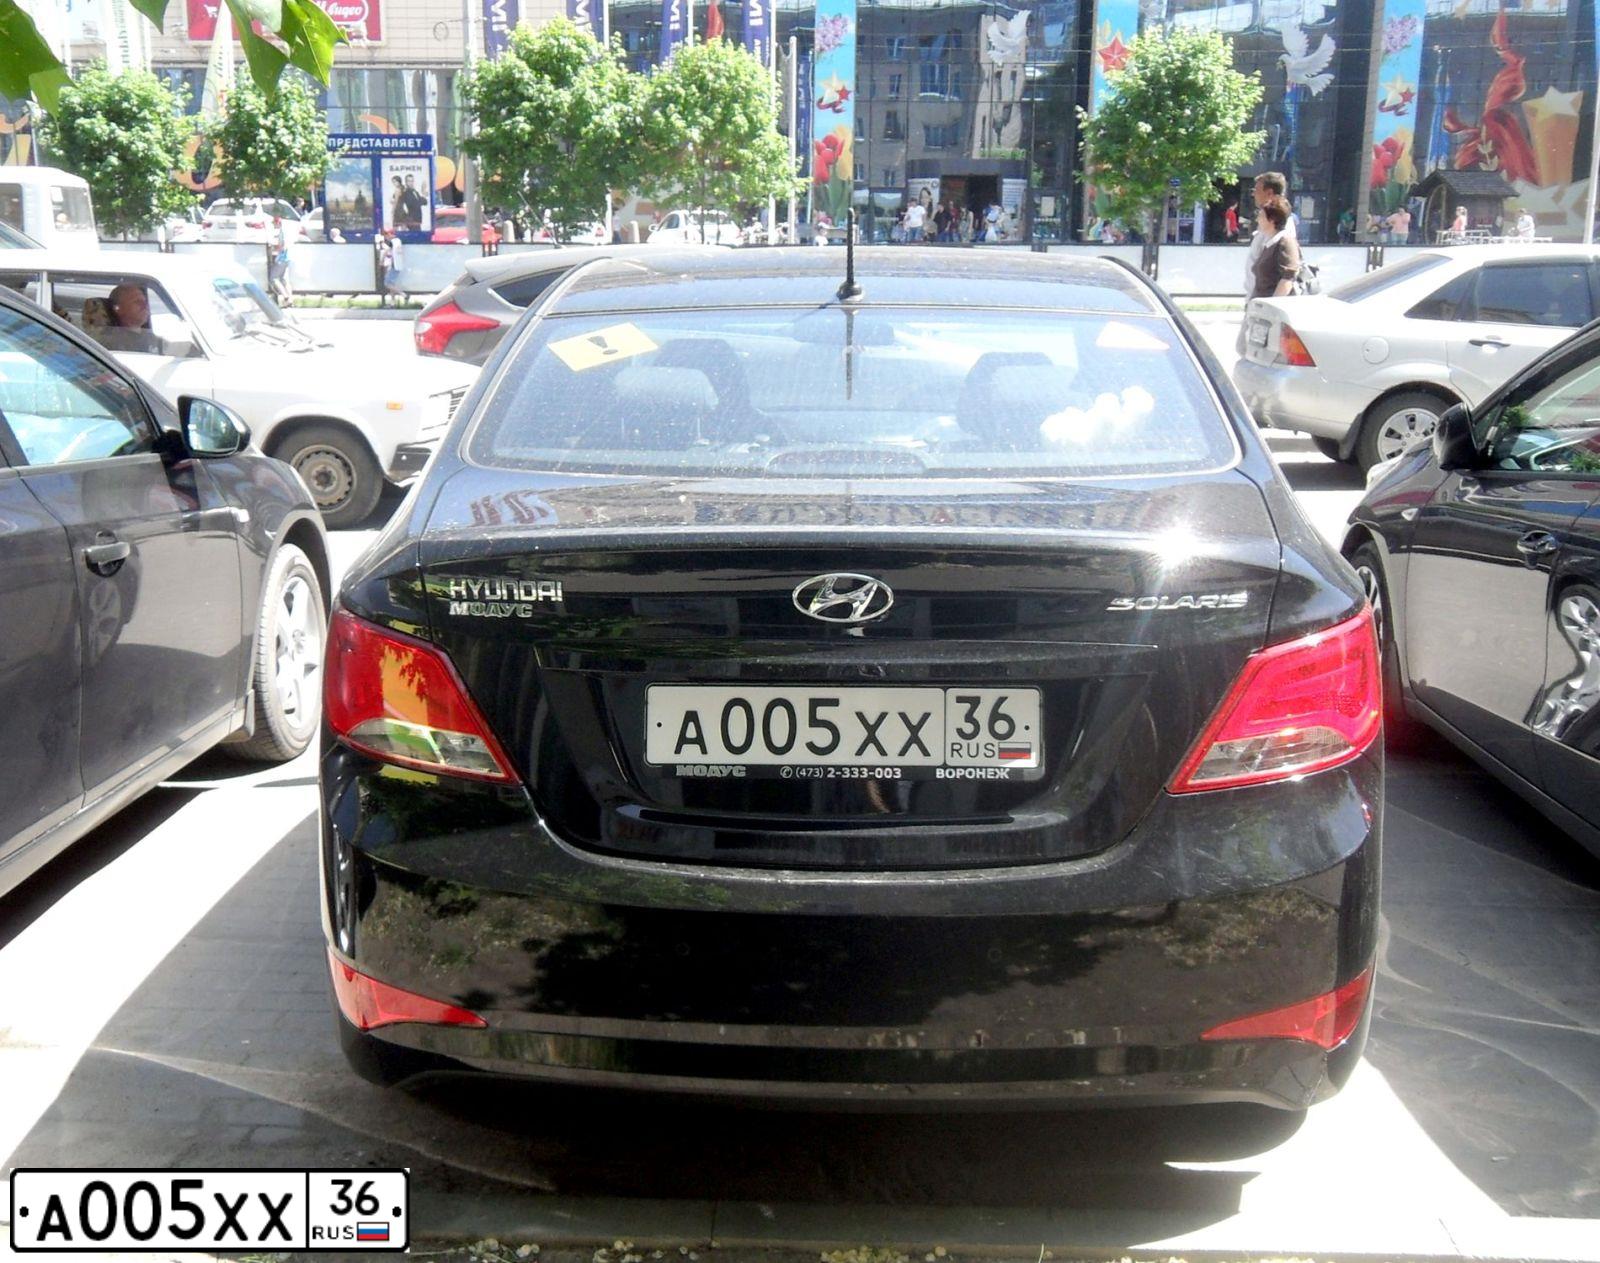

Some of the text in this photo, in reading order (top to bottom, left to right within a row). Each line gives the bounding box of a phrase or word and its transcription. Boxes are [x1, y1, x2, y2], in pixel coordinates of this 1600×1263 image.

[328, 137, 423, 149] ПРЕДСТАВЛЯЕТ
[450, 578, 563, 601] HYUNDAI
[1105, 590, 1248, 611] SOLARIS
[449, 601, 533, 617] МОДУС
[955, 696, 1016, 740] 36
[950, 742, 996, 758] RUS
[676, 765, 1011, 779] МОДУС (473) 2-333-003 ВОРОНЕЖ
